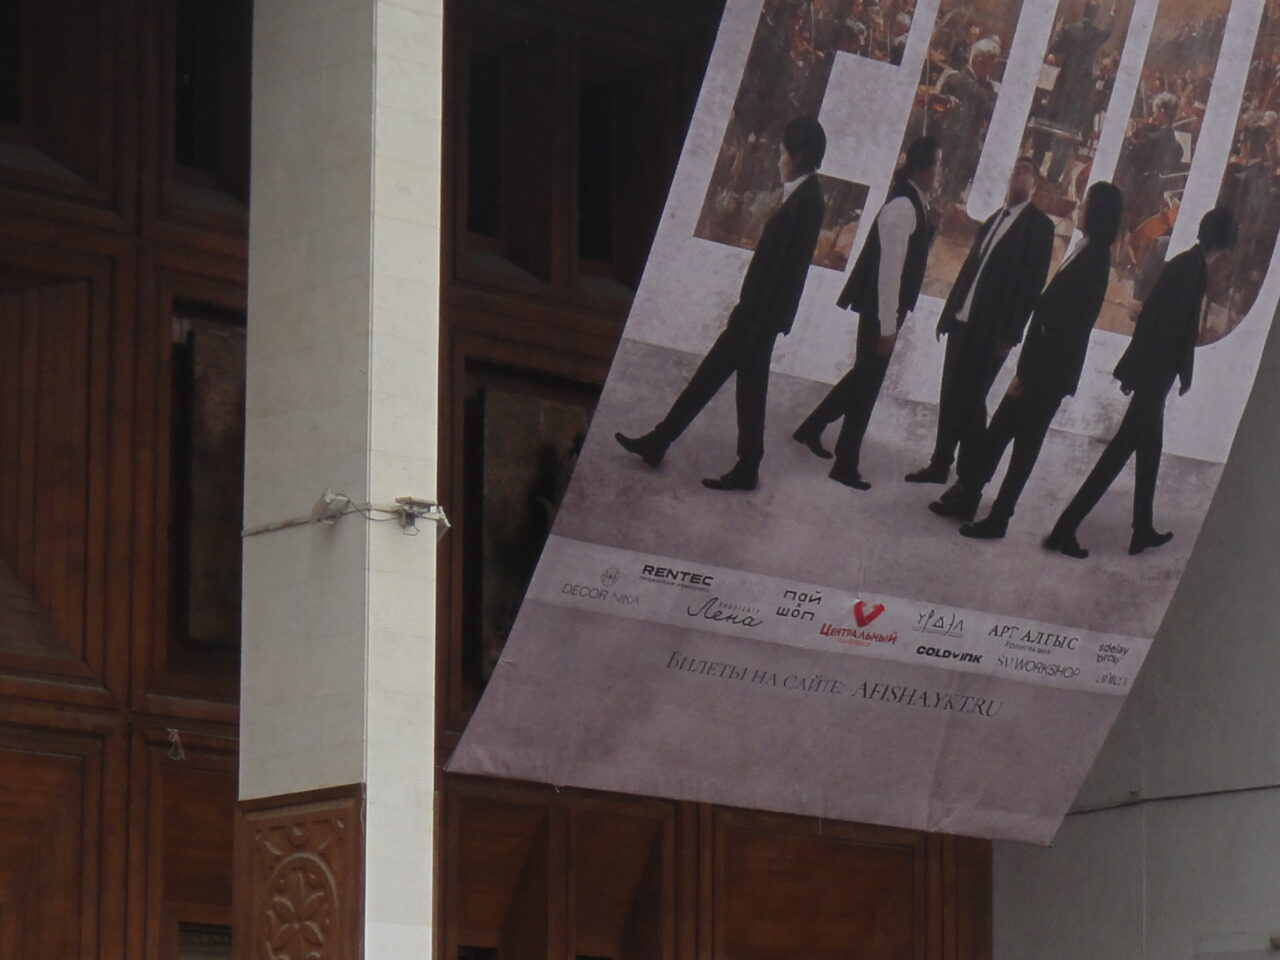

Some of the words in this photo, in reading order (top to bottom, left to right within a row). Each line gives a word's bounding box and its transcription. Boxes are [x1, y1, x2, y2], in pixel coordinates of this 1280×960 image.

[641, 565, 714, 587] RENTEC
[561, 583, 609, 601] DECOR
[687, 597, 763, 627] Лена
[988, 624, 1019, 640] АРТ
[1020, 629, 1079, 650] АЛГЫС
[666, 650, 748, 681] БИЛЕТЫ
[751, 669, 777, 687] НА
[1014, 656, 1080, 679] WORKSHOP
